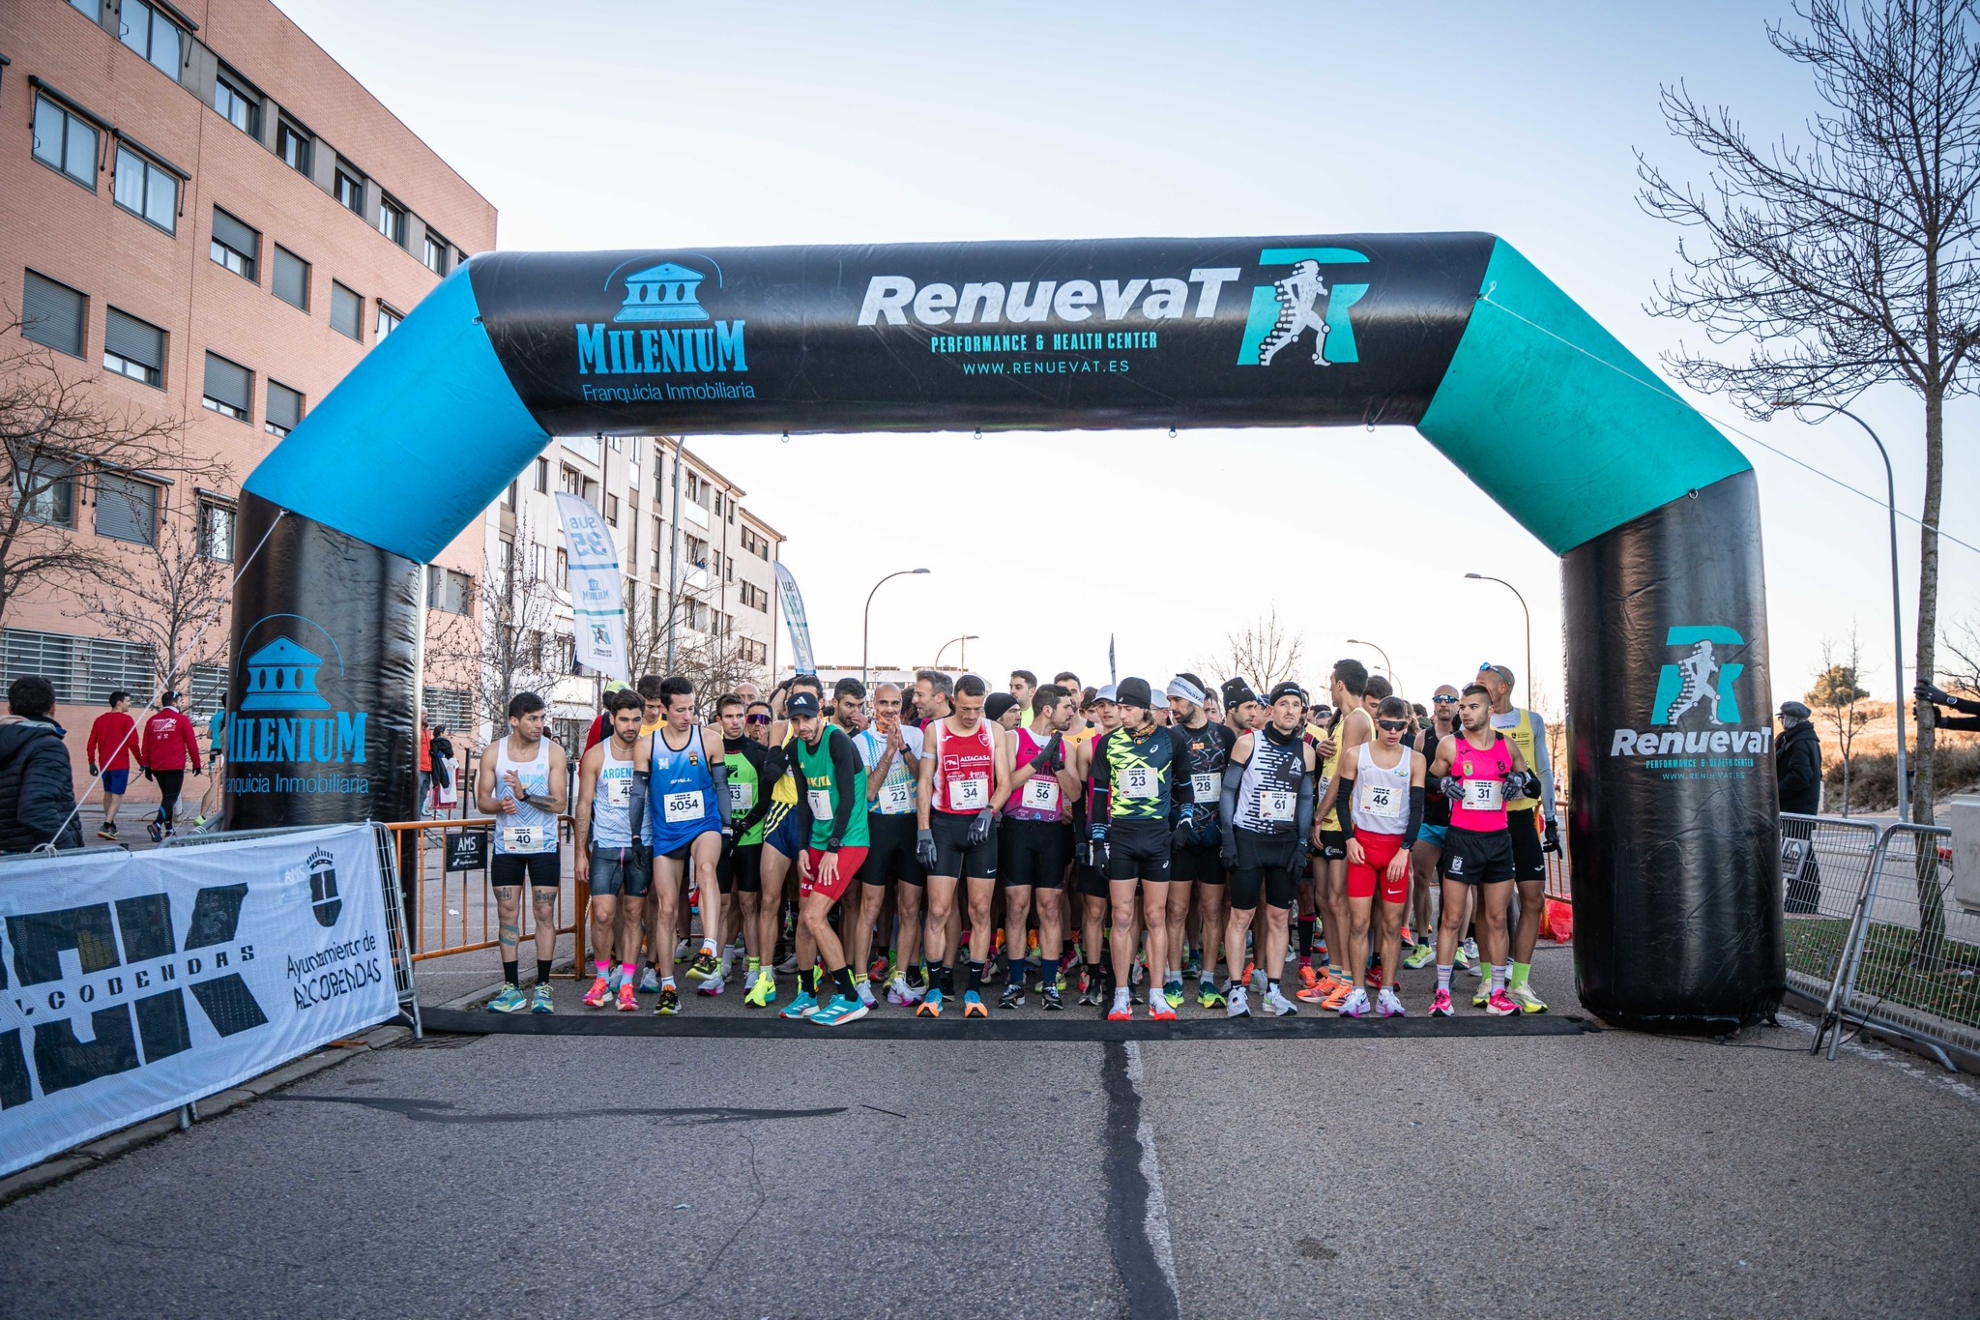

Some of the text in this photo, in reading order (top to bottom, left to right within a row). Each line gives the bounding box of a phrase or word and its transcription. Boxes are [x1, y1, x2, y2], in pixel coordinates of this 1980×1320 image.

[858, 268, 1241, 326] RenuevaT
[575, 320, 748, 374] MILENIUM
[931, 332, 1158, 353] PERFORMANCE & HEALTH CENTER
[963, 360, 1130, 375] WWW.RENUEVAT.ES
[582, 382, 756, 403] Franquicia Inmobiliaria
[1611, 726, 1772, 757] RenuevaT
[1645, 758, 1697, 769] PERFORMANCE
[603, 767, 634, 779] ARGEN
[225, 773, 370, 797] anquicia Inmobiliaria
[1130, 776, 1146, 787] 23
[1196, 781, 1211, 792] 28
[890, 790, 907, 802] 22
[963, 787, 978, 799] 34
[1035, 788, 1049, 799] 56
[1372, 794, 1389, 806] 46
[1477, 788, 1490, 799] 31
[670, 798, 699, 812] 5054
[1274, 799, 1286, 810] 61
[457, 836, 477, 852] AMS
[515, 834, 531, 844] 40
[362, 930, 376, 952] de
[0, 945, 255, 1021] LCOBENDAS
[293, 957, 382, 1013] ALCOBENDAS
